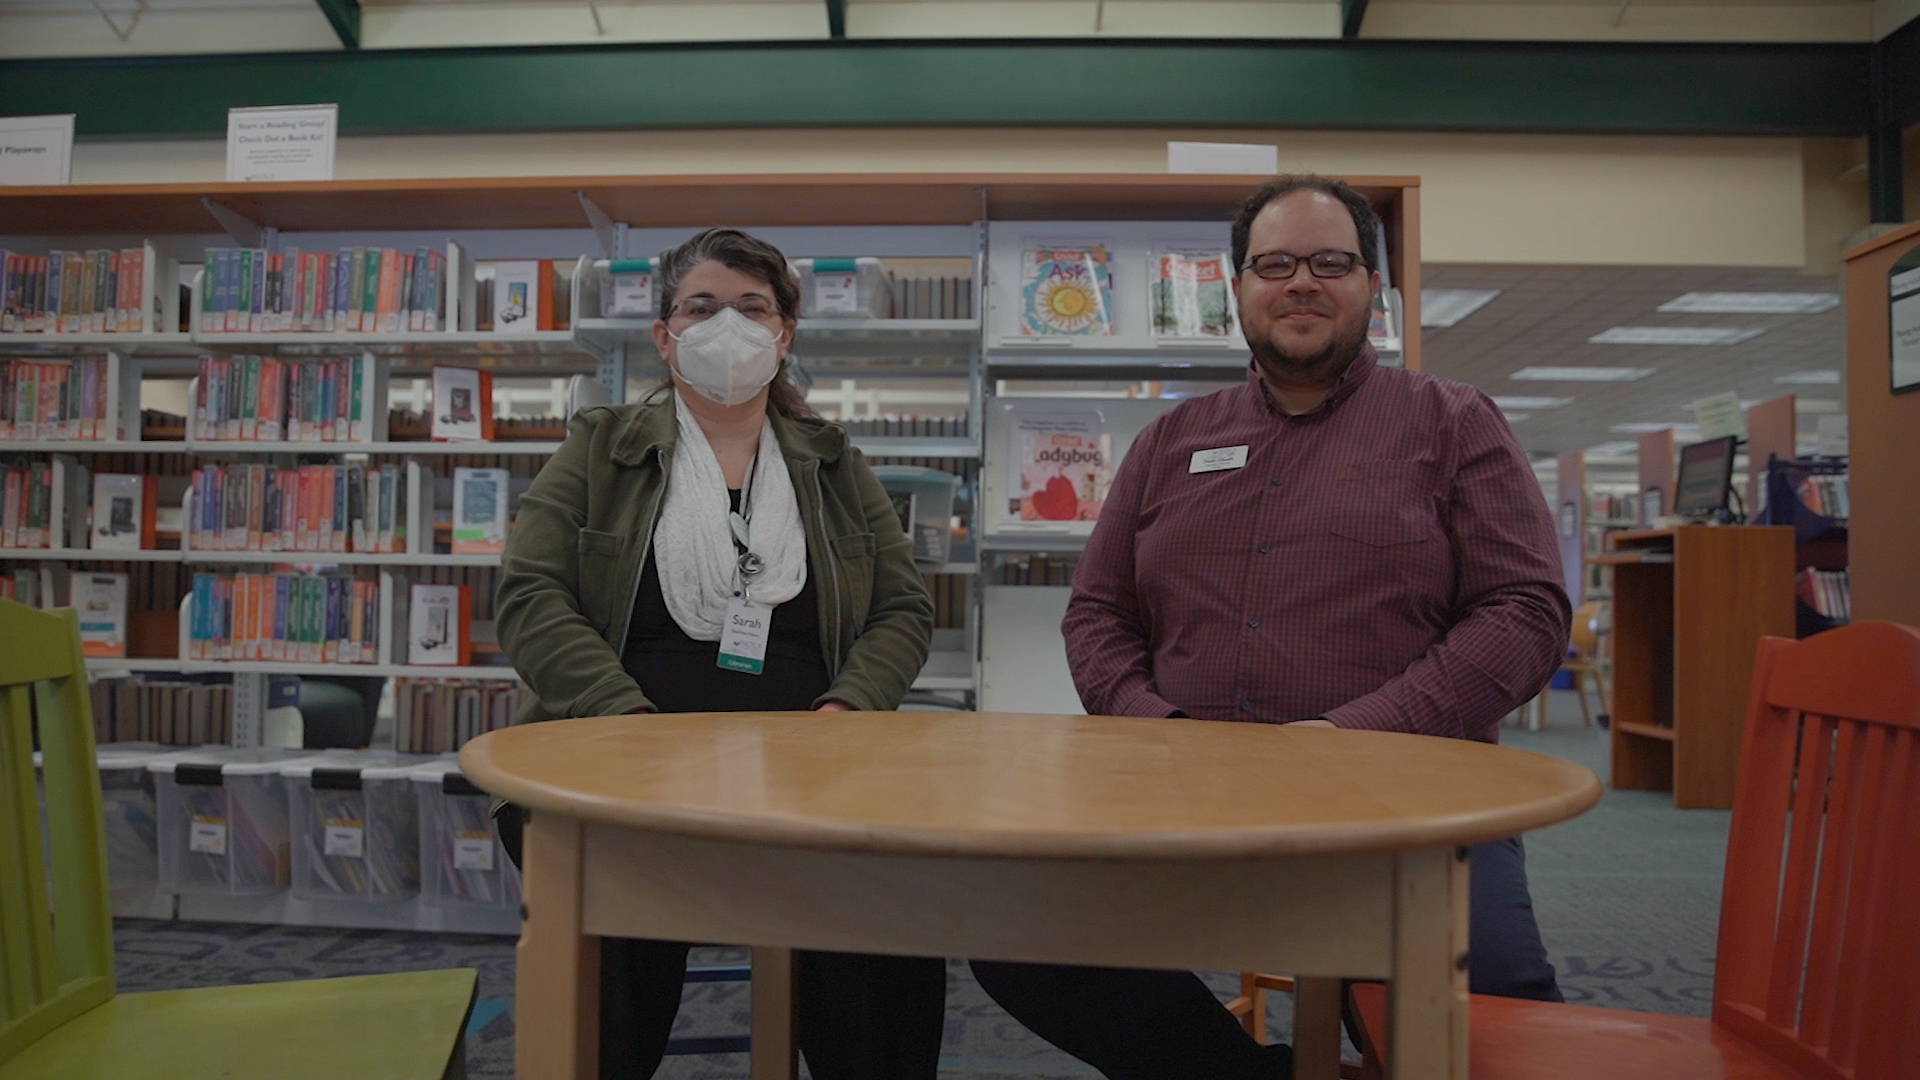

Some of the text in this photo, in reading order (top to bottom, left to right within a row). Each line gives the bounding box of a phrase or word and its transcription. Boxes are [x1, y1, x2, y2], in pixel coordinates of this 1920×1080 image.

[266, 122, 296, 130] Reading
[238, 135, 262, 144] Check
[264, 135, 280, 143] Out
[288, 134, 308, 142] Book
[5, 146, 47, 156] Playaways
[1049, 264, 1086, 281] Ask
[733, 614, 762, 628] Sarah
